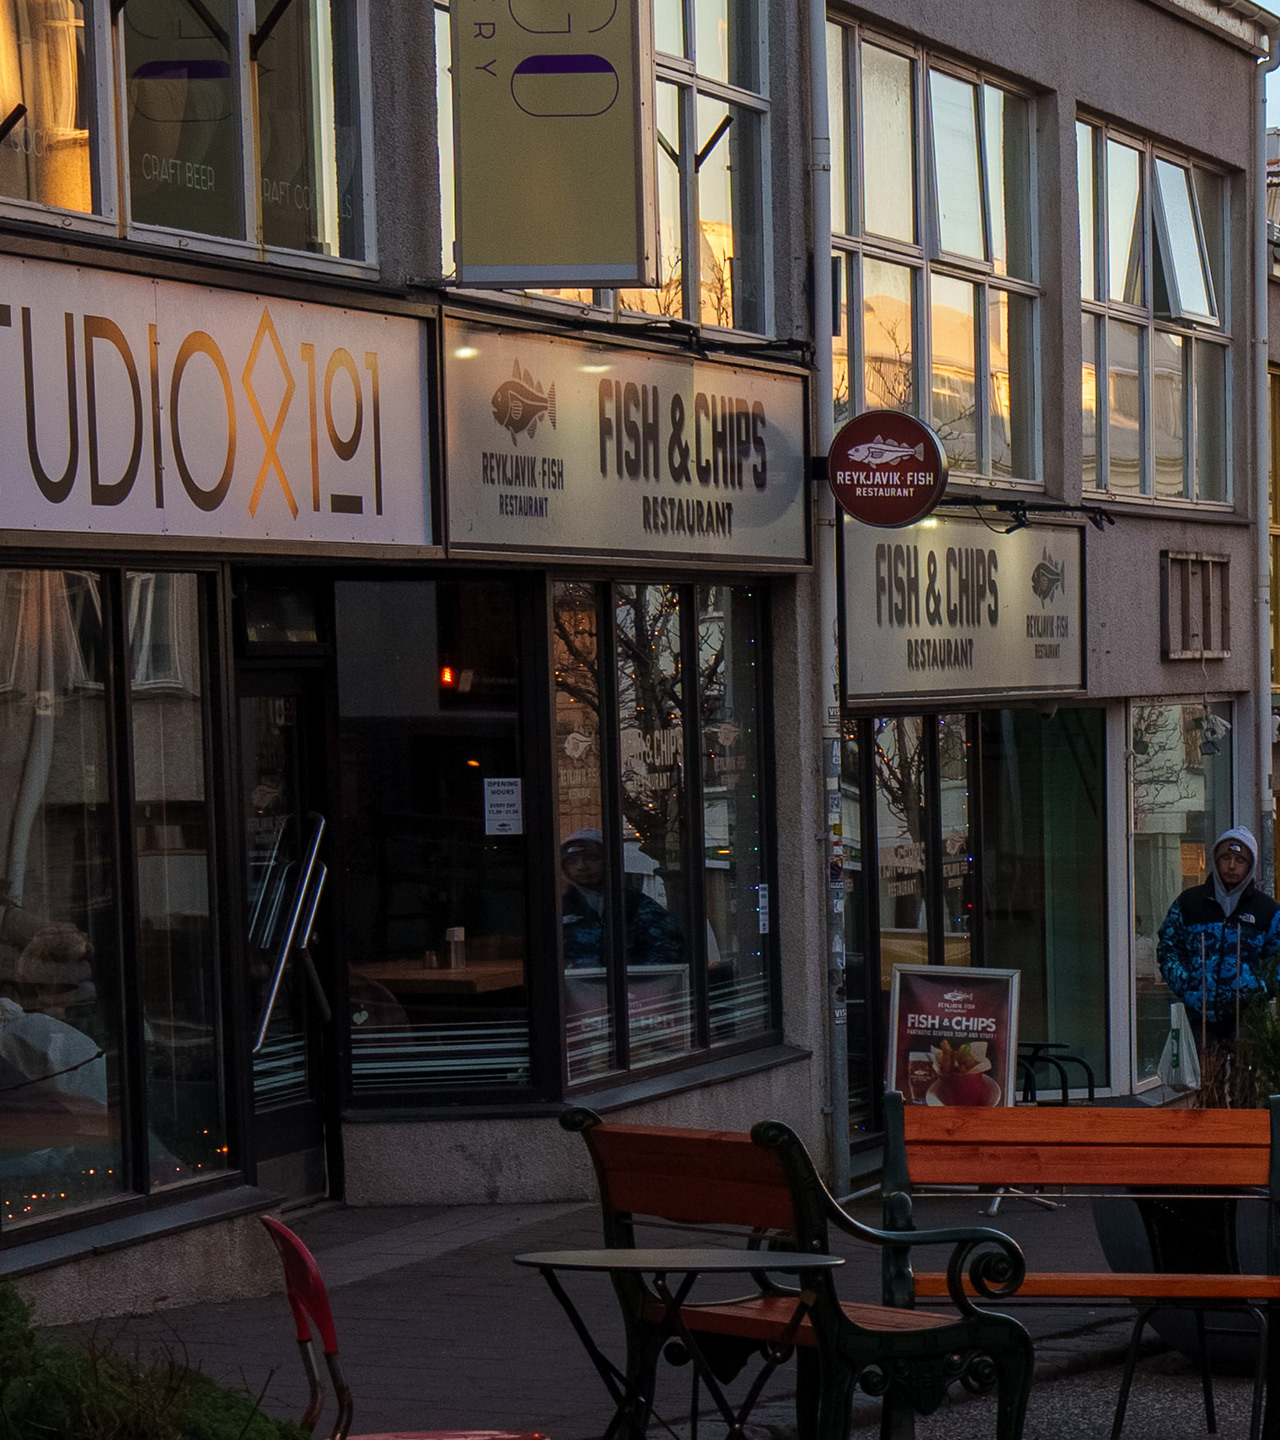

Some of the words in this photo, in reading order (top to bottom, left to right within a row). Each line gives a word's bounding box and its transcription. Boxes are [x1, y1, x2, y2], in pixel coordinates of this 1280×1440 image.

[142, 152, 182, 186] CRAFT
[186, 162, 215, 192] BEER
[0, 304, 237, 512] UDIO
[598, 377, 661, 483] FISH
[668, 393, 692, 483] &
[694, 391, 768, 493] CHIPS
[482, 451, 537, 488] REYKJAVIK
[541, 457, 565, 491] FISH
[836, 471, 901, 486] REYKJAVIK
[906, 471, 934, 486] FISH
[499, 493, 549, 518] RESTAURANT
[856, 487, 915, 498] RESTAURANT
[642, 495, 734, 538] RESTAURANT
[875, 543, 921, 629] FISH
[925, 550, 943, 627] &
[945, 546, 1000, 629] CHIPS
[907, 638, 974, 671] RESTAURANT
[1034, 643, 1061, 660] RESTAURANT
[487, 780, 519, 788] OPENING
[907, 1013, 940, 1029] FISH
[942, 1018, 951, 1027] &
[951, 1015, 997, 1032] CHIPS
